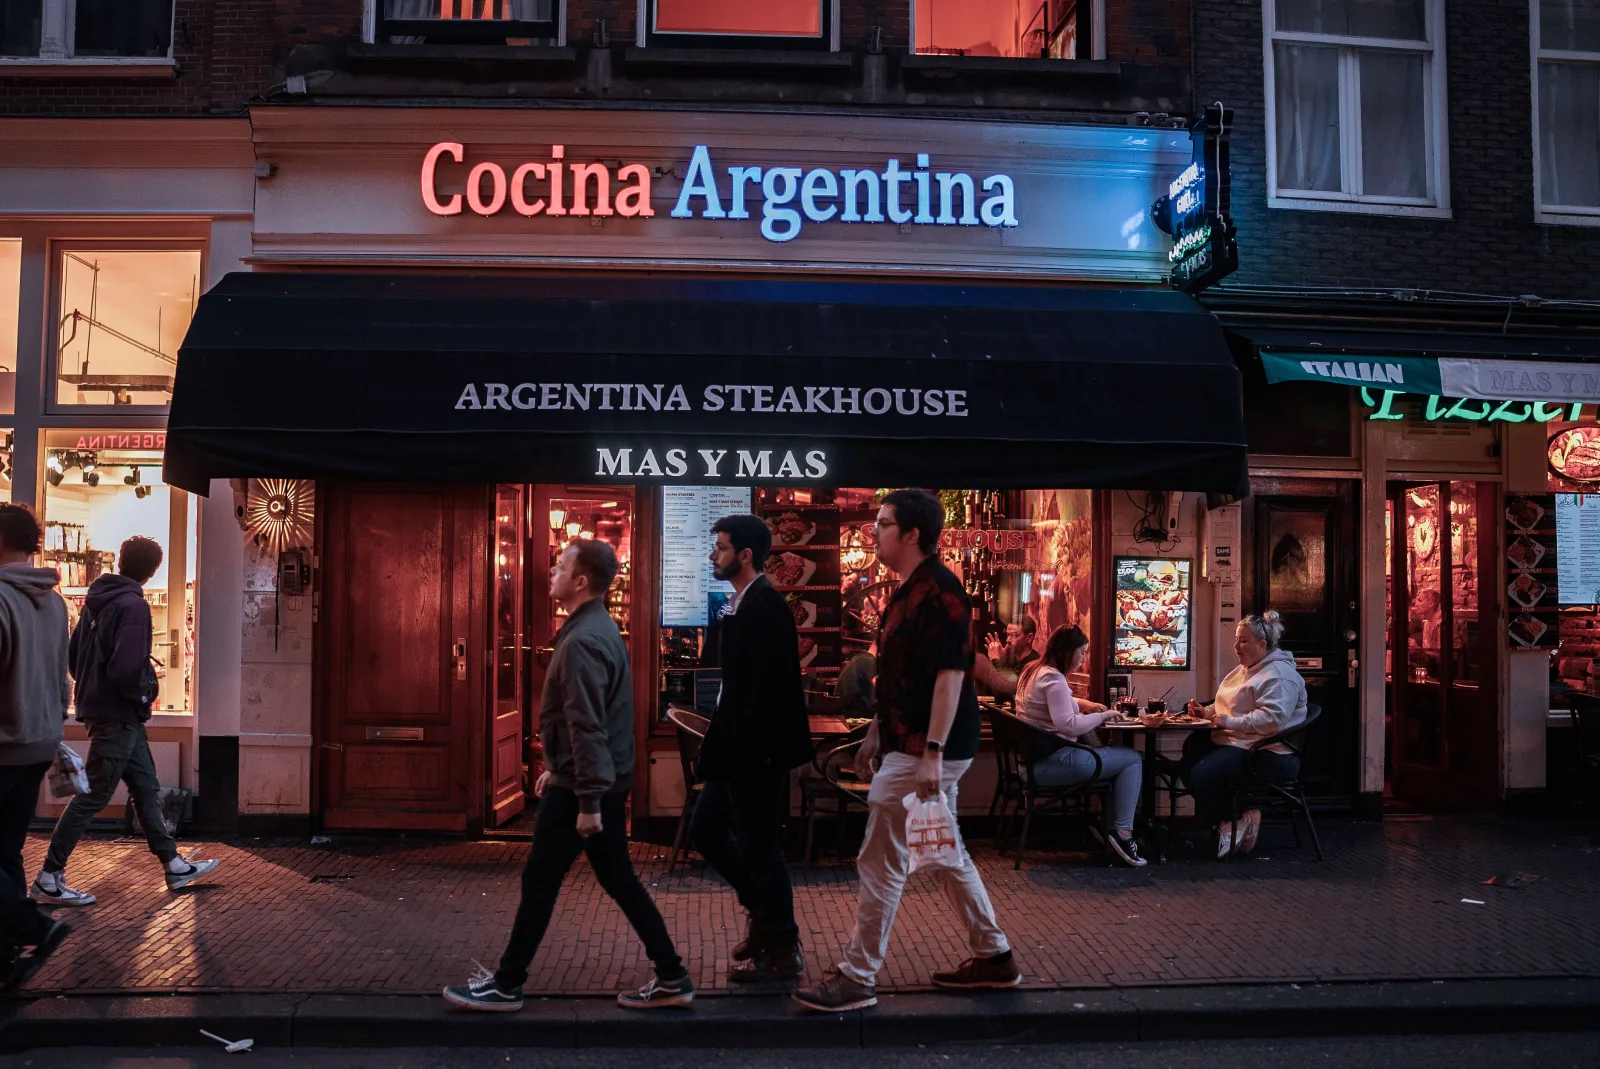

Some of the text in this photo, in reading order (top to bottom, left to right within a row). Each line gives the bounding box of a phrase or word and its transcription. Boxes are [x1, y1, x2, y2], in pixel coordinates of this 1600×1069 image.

[421, 142, 1019, 242] Cocina Argentina
[1300, 361, 1404, 384] ITALIAN
[1489, 369, 1552, 393] MAS
[1556, 371, 1577, 393] Y
[454, 382, 969, 417] ARGENTINA STEAKHOUSE
[595, 448, 828, 478] MAS Y MAS
[861, 523, 1038, 553] SKHOUSE
